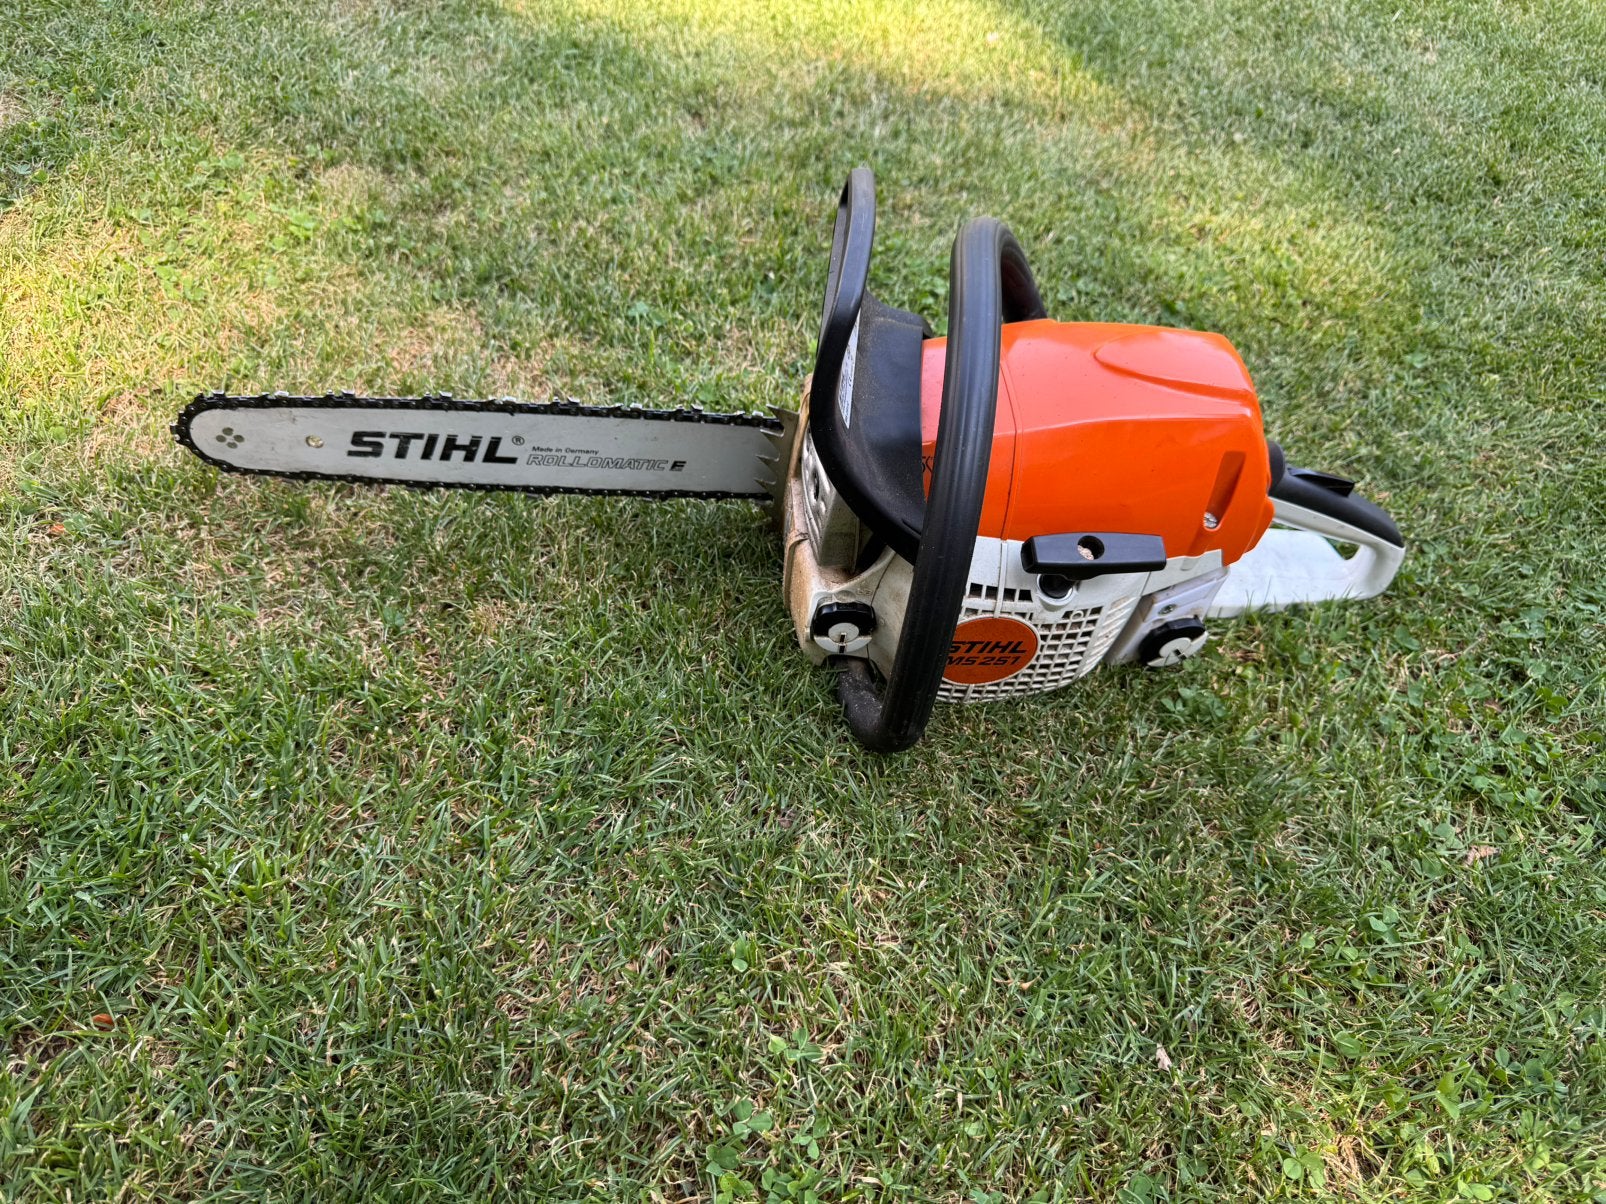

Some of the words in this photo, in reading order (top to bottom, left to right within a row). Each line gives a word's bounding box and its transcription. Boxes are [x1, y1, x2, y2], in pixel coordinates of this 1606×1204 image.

[531, 446, 554, 454] Made
[565, 447, 600, 456] Germany
[526, 453, 669, 472] ROLLOMATIC
[669, 460, 688, 472] E
[948, 640, 1027, 654] STIHL
[946, 655, 980, 666] MS
[978, 655, 1022, 666] 251
